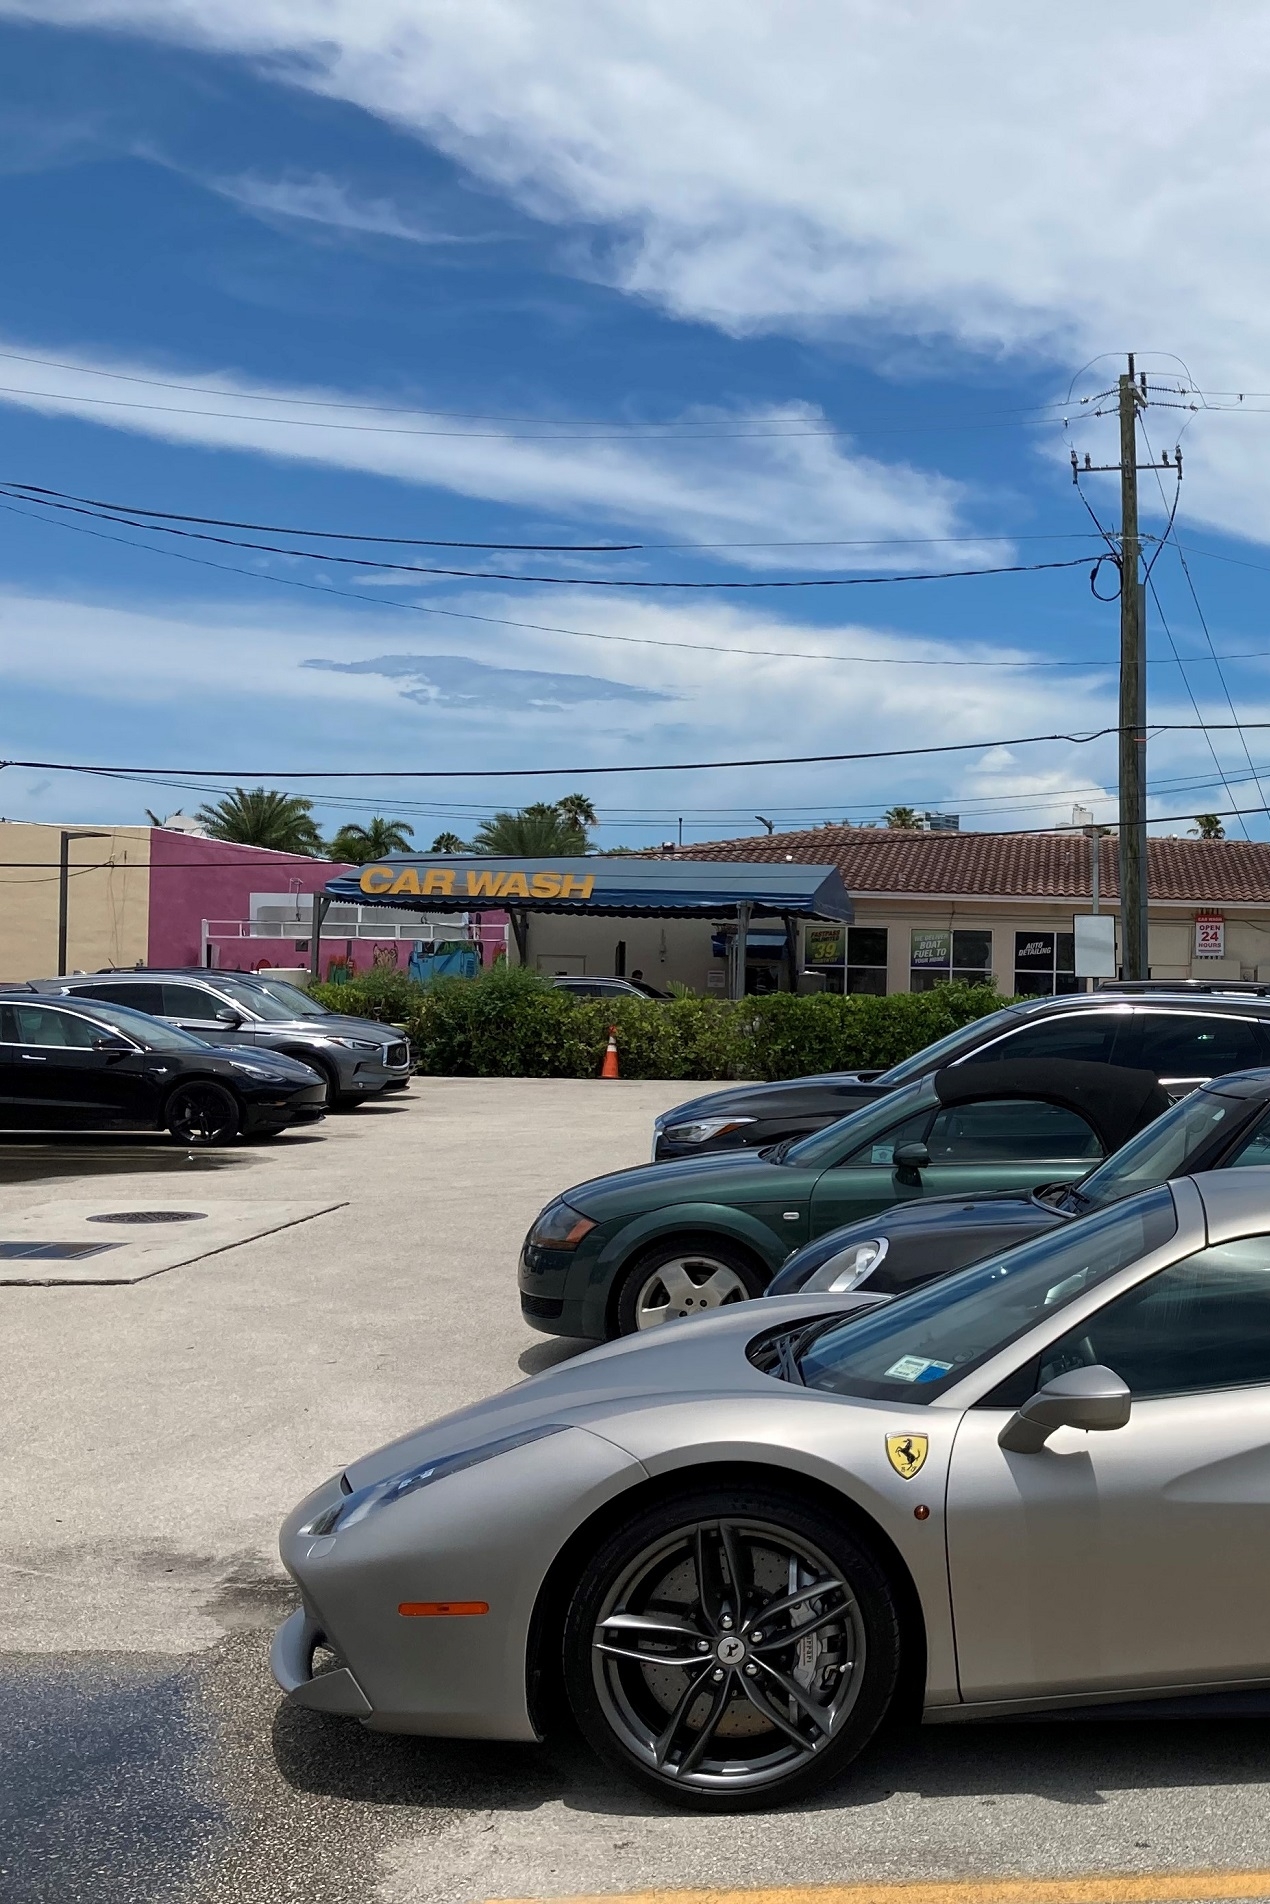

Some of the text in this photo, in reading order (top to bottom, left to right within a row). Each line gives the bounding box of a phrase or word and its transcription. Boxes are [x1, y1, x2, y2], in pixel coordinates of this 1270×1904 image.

[359, 866, 596, 899] CAR WASH
[1201, 931, 1219, 941] 24
[920, 940, 942, 949] BOAT
[1025, 941, 1044, 950] AUTO
[913, 948, 947, 959] FUEL TO
[1018, 946, 1052, 956] DETAILING
